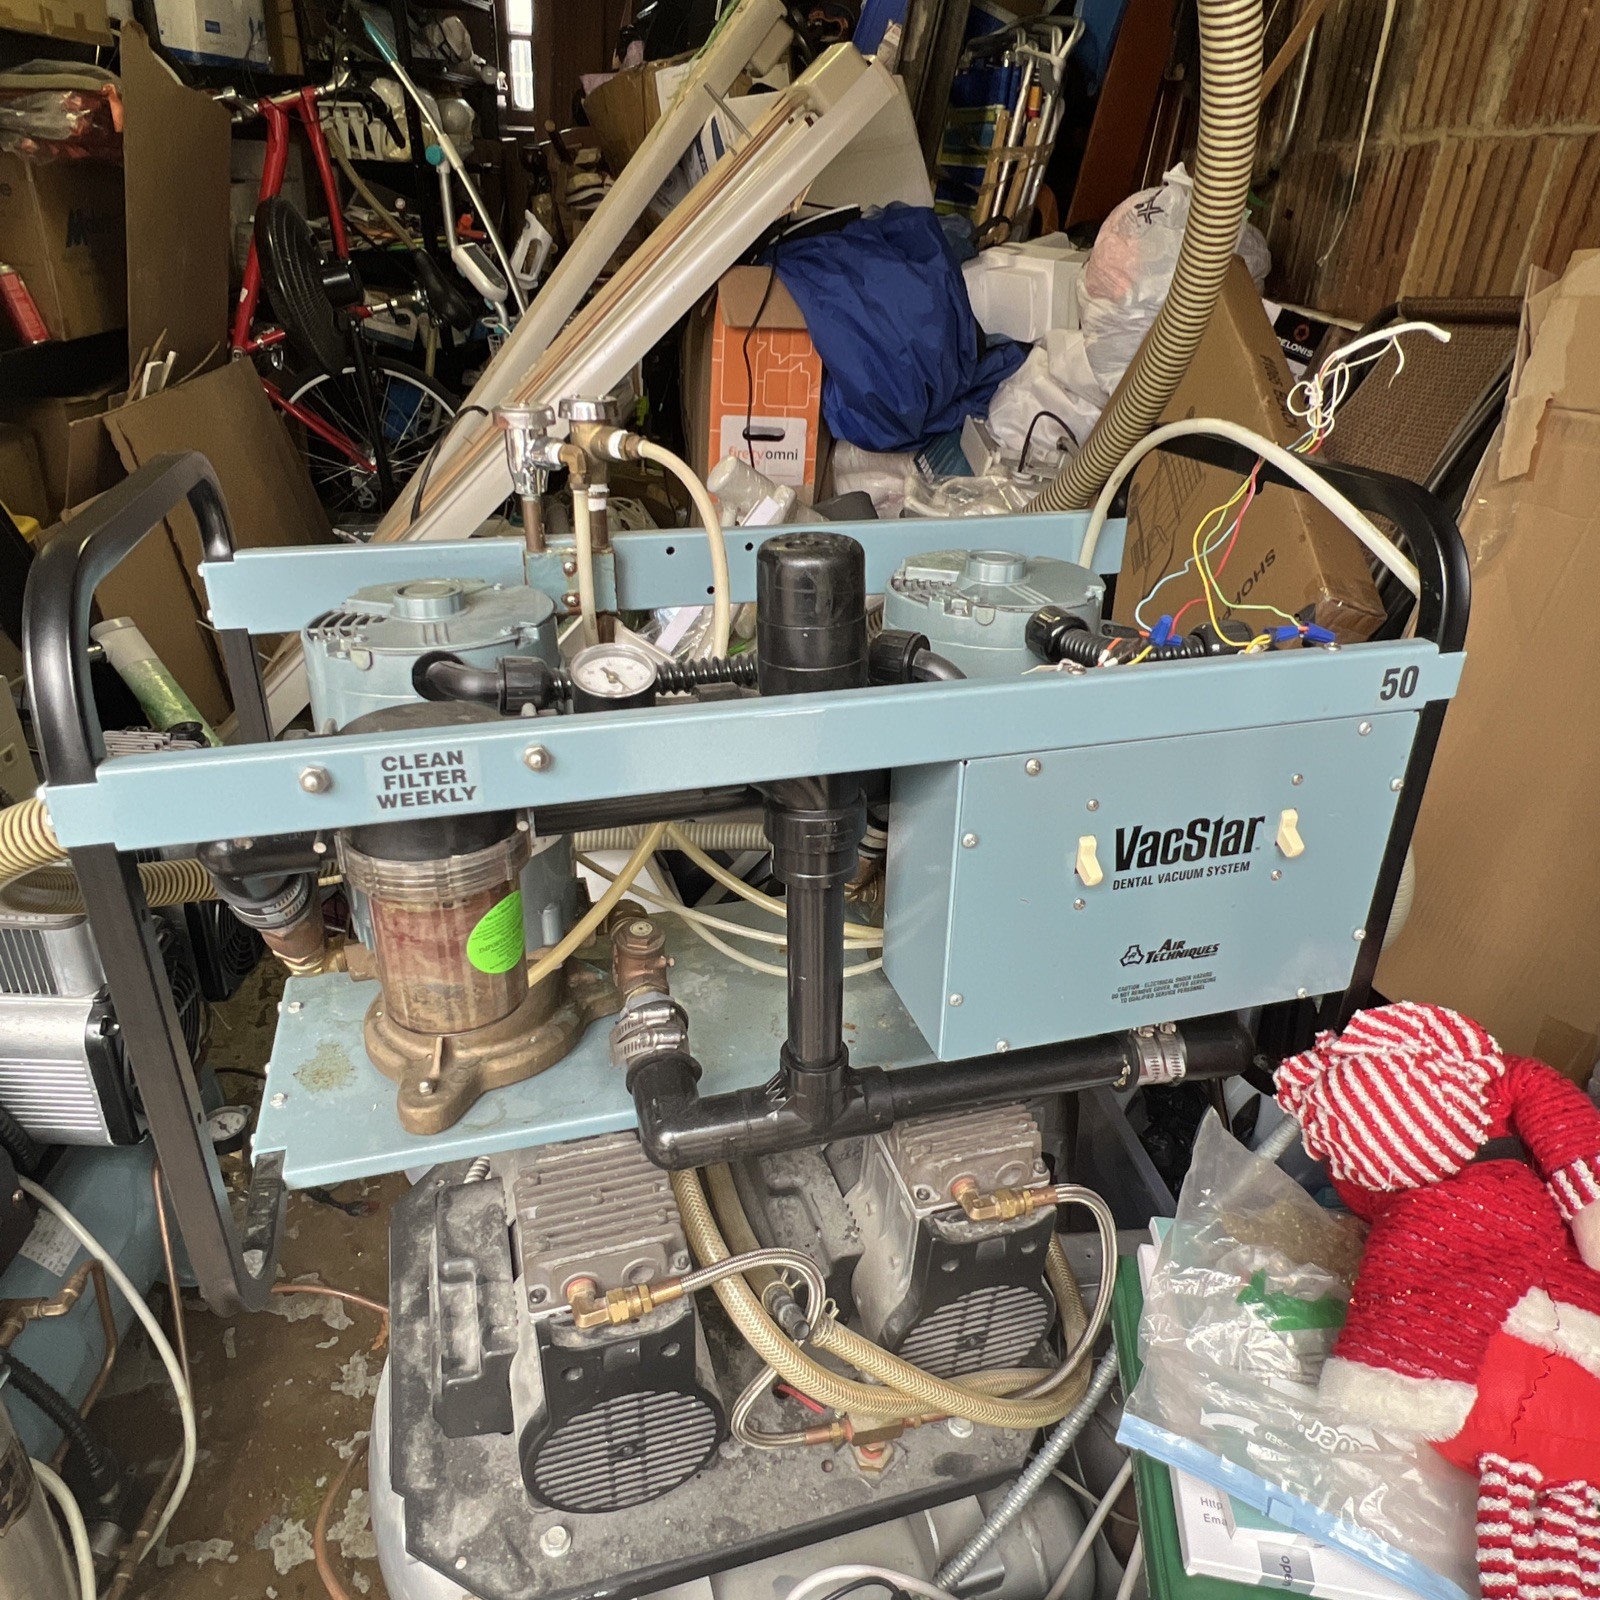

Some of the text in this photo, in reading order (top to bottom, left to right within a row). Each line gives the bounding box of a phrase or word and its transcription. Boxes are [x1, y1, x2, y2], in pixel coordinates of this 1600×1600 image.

[765, 448, 799, 461] omni
[1218, 548, 1276, 621] SHOPP
[1380, 665, 1419, 701] 50
[381, 750, 464, 771] CLEAN
[383, 768, 468, 790] FILTER
[376, 785, 477, 809] WEEKLY
[1115, 814, 1265, 872] VacStar
[1112, 861, 1250, 891] DENTAL VACUUM SYSTEM
[1145, 943, 1220, 964] TECHNIQUES
[1158, 938, 1186, 953] AIR
